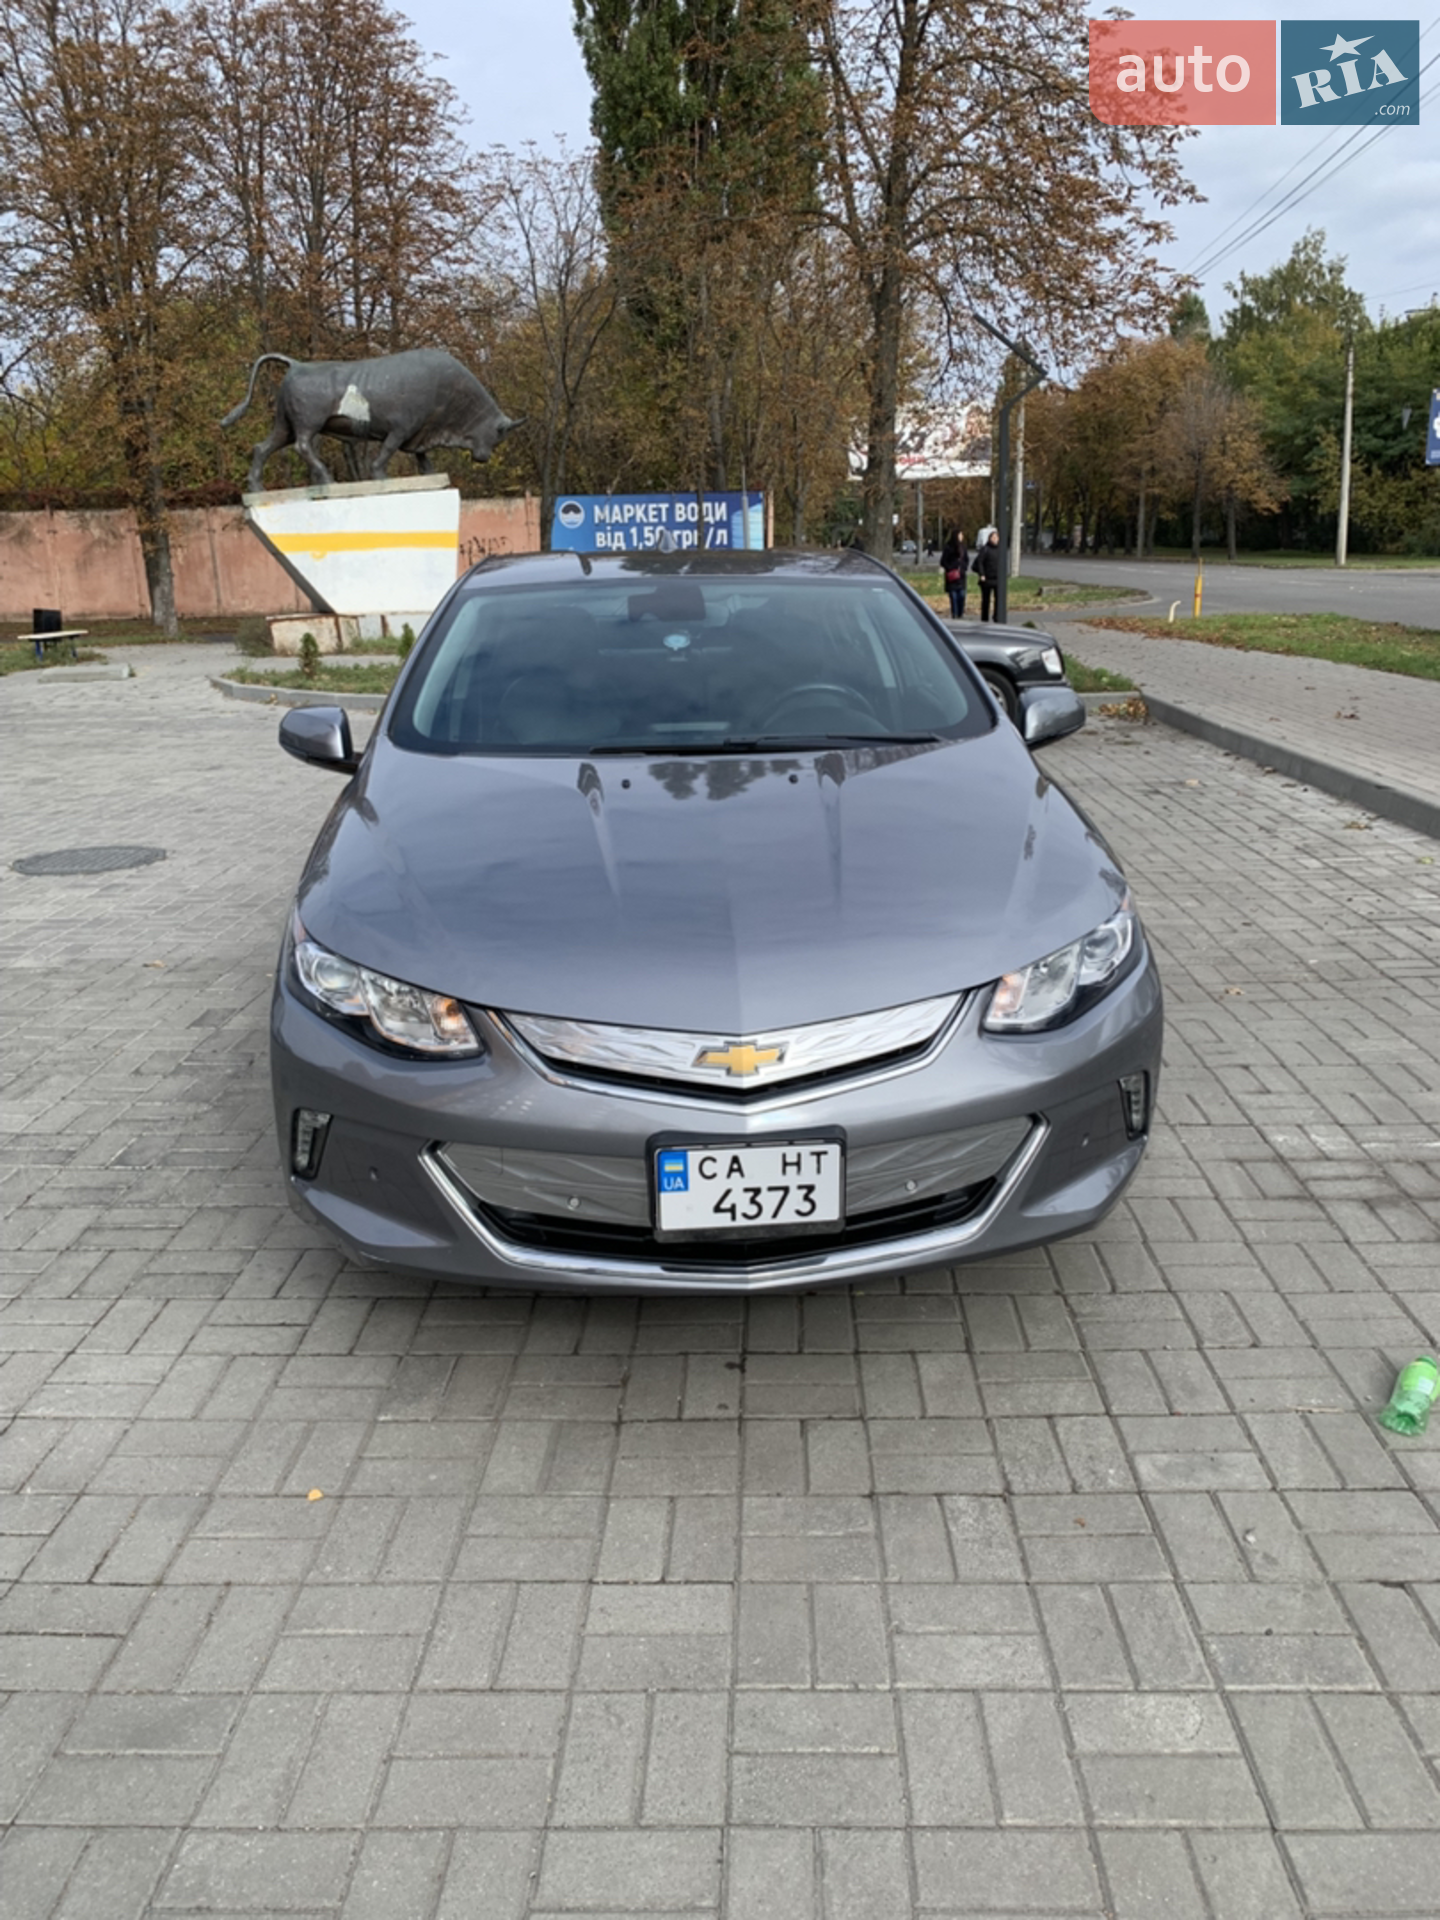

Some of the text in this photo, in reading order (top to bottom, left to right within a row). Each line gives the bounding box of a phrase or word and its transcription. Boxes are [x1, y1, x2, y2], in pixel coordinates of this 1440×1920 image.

[593, 502, 727, 525] МАРКЕТ ВОДИ
[596, 526, 626, 551] від
[698, 1151, 829, 1180] CA HT
[663, 1177, 685, 1190] UA
[713, 1184, 817, 1221] 4373
